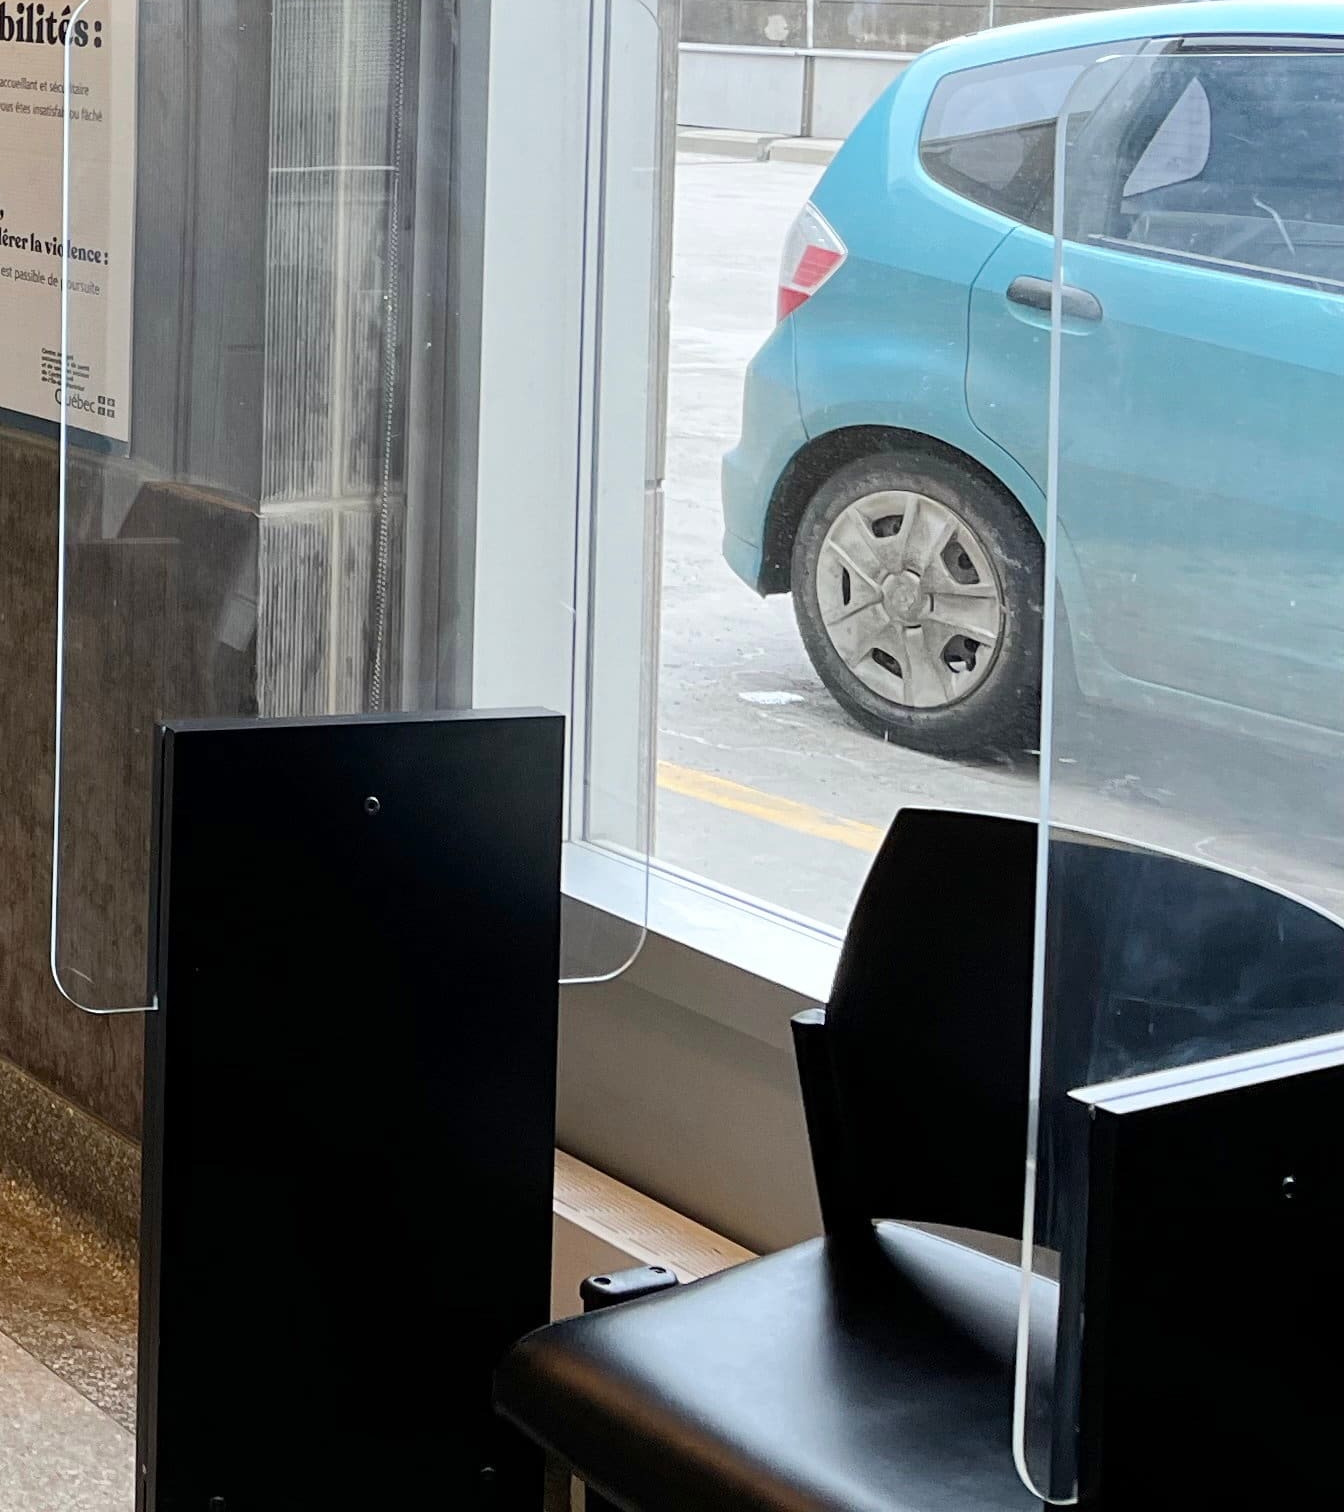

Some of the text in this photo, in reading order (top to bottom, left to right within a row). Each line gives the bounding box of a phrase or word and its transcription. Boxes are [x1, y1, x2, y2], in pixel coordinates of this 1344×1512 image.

[0, 77, 38, 90] accueillant
[39, 82, 47, 92] et
[15, 101, 31, 115] êtes
[32, 104, 68, 118] insatisfai
[30, 232, 42, 253] la
[44, 236, 102, 264] violence
[0, 266, 13, 278] est
[14, 269, 46, 284] passible
[47, 273, 59, 287] de
